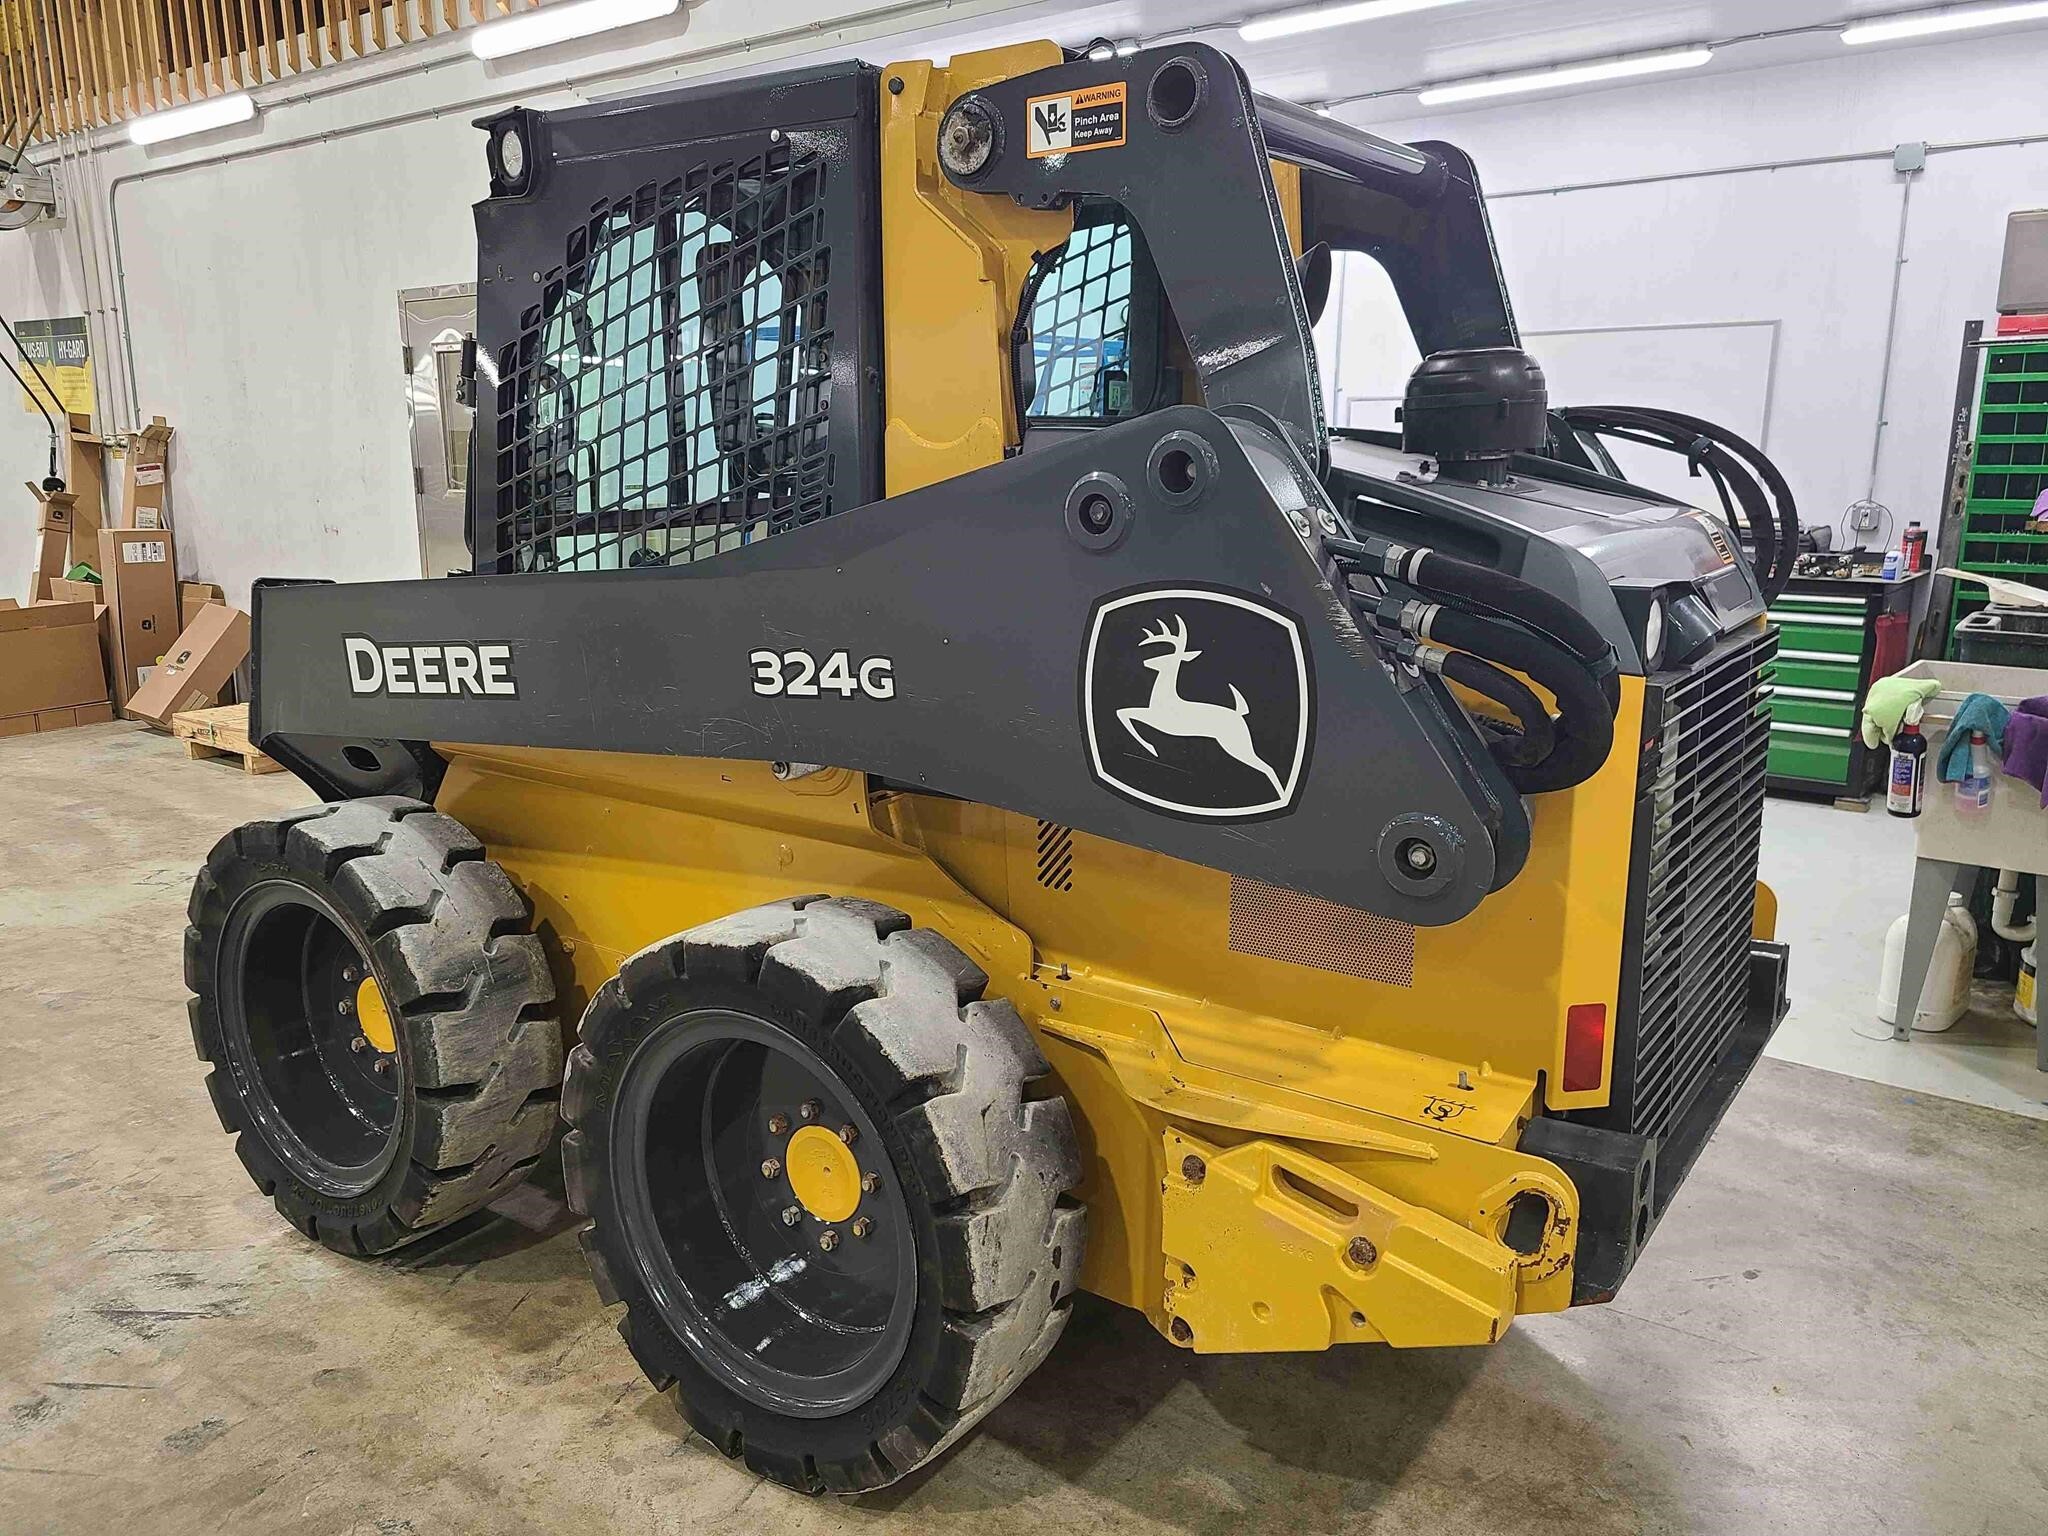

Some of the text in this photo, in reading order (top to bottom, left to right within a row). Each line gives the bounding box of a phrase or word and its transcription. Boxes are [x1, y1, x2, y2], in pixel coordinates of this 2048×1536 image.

[1083, 89, 1121, 103] WARNING
[1074, 112, 1120, 127] Pinch Area
[1074, 126, 1113, 139] Keep Away
[57, 339, 86, 359] HY-GARD
[344, 637, 516, 695] DEERE
[750, 650, 895, 699] 324G
